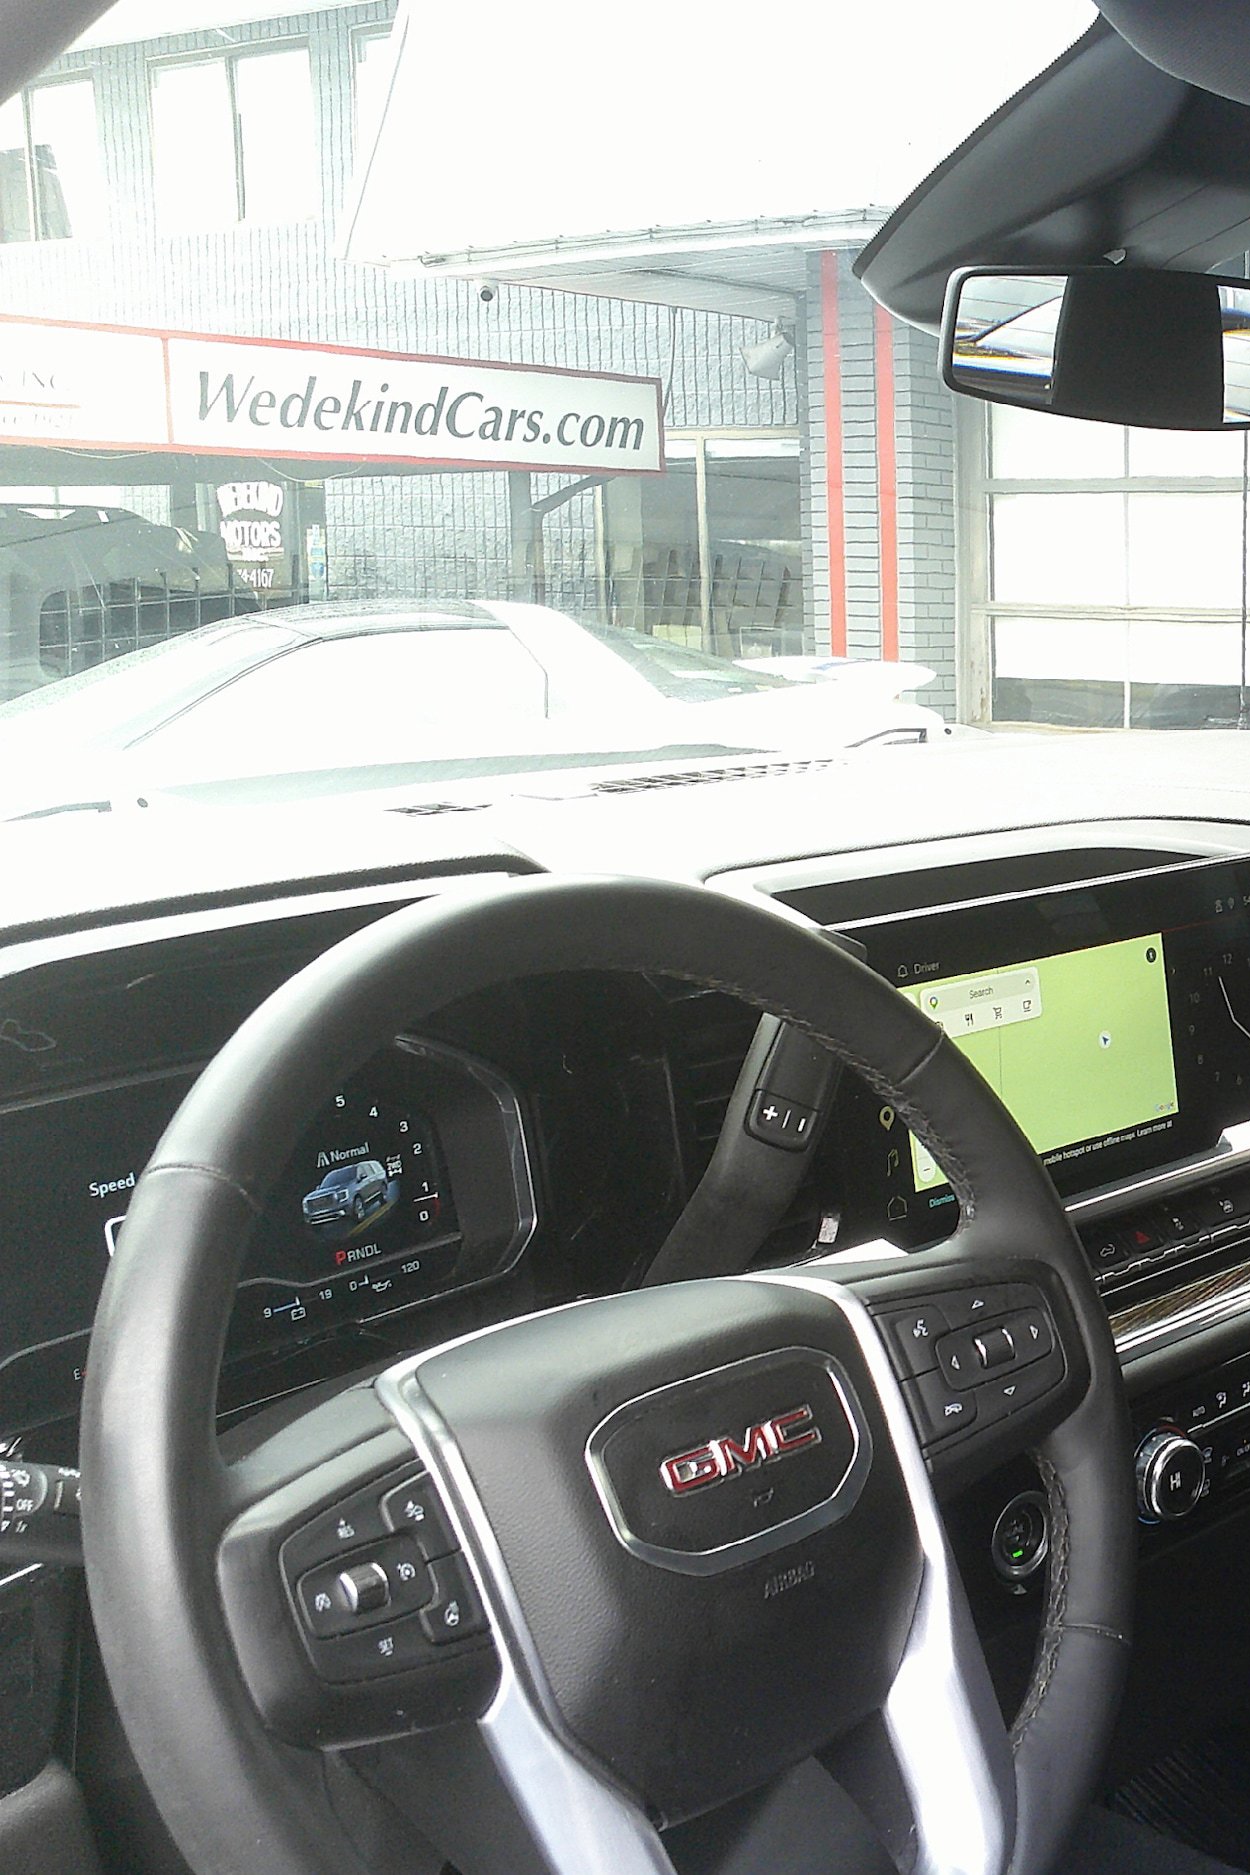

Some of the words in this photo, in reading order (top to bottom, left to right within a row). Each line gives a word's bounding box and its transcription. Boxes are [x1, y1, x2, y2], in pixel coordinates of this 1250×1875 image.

[198, 371, 646, 451] WedekindCars.com
[220, 520, 281, 548] MOTORS
[914, 962, 941, 975] Driver
[969, 986, 994, 1000] Search
[335, 1095, 346, 1107] 5
[369, 1106, 379, 1118] 4
[399, 1121, 409, 1133] 3
[330, 1142, 370, 1163] Normal
[412, 1142, 422, 1155] 2
[88, 1171, 136, 1199] Speed
[421, 1181, 429, 1192] 1
[419, 1210, 429, 1222] 0
[349, 1280, 358, 1292] 0
[401, 1260, 420, 1274] 120
[263, 1308, 273, 1319] 9
[318, 1288, 333, 1301] 19
[660, 1404, 823, 1498] GMC
[1170, 1471, 1181, 1491] HI
[16, 1498, 33, 1512] OFF
[764, 1561, 815, 1599] AIRBAG
